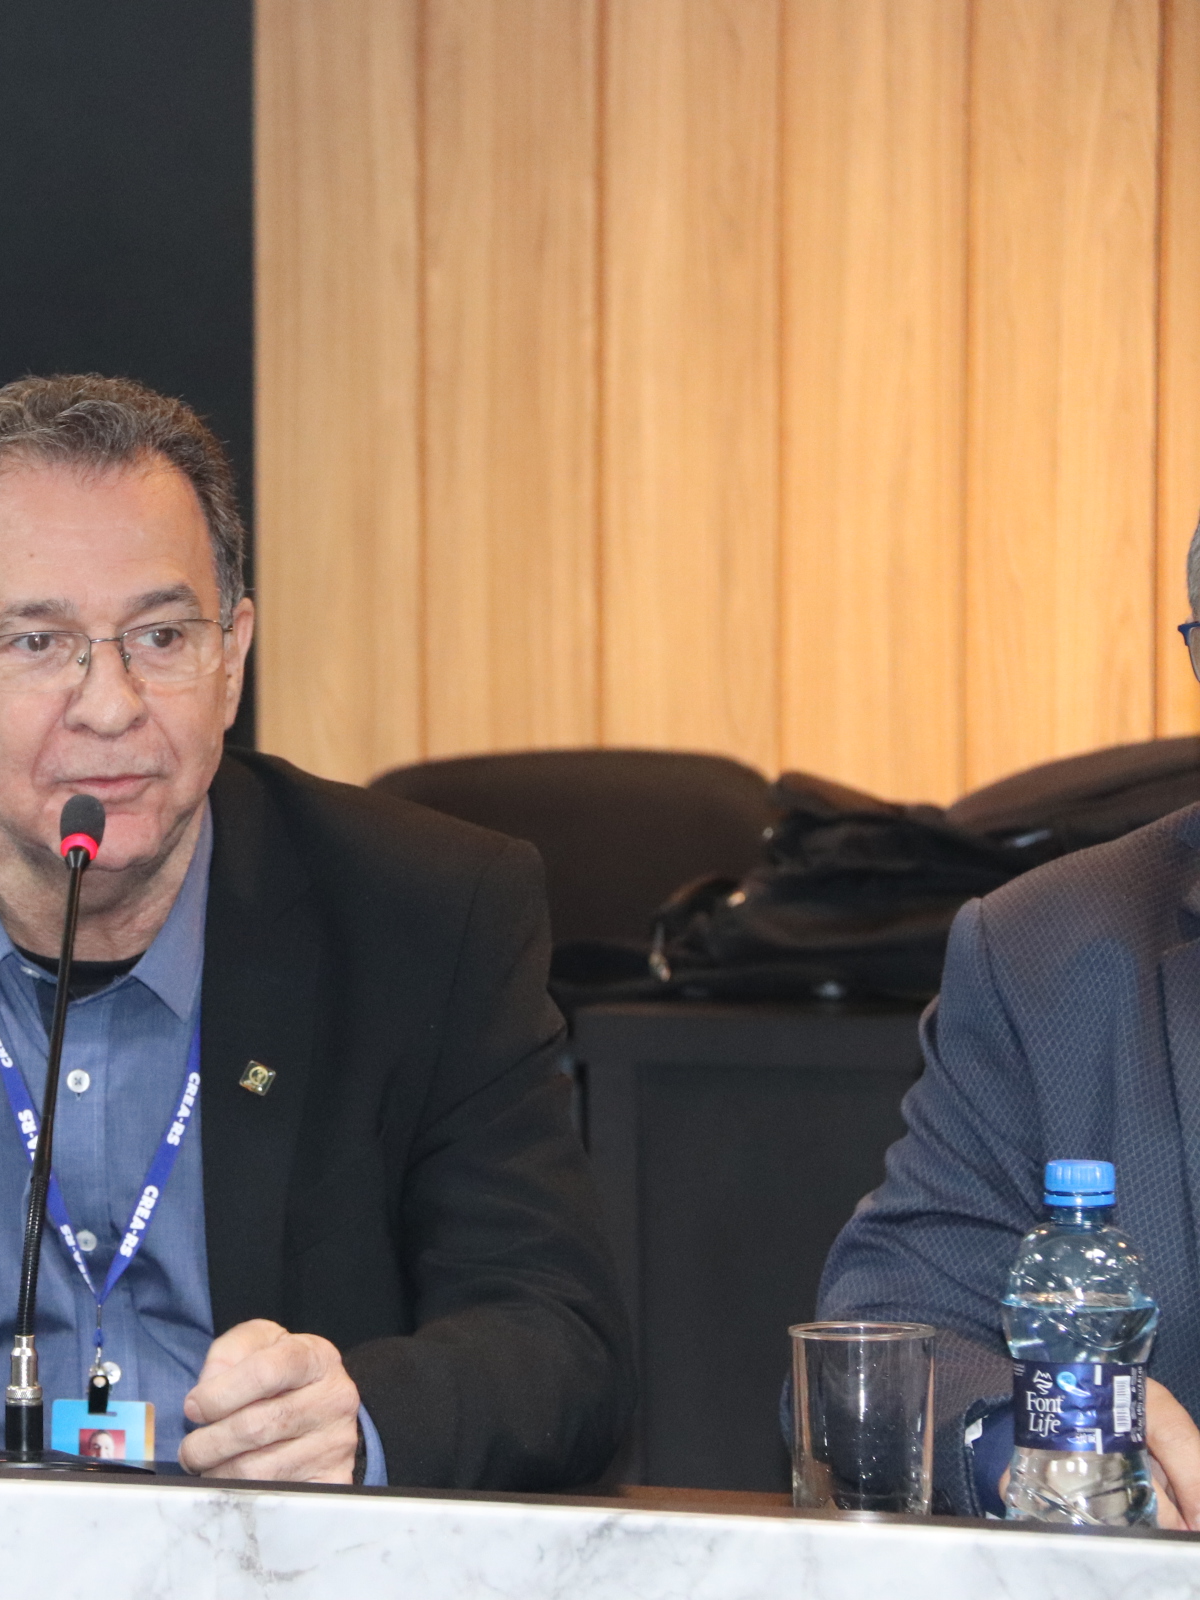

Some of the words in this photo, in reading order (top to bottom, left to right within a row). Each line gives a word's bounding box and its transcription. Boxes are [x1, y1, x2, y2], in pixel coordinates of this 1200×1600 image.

[17, 1109, 39, 1161] A-RS
[166, 1071, 200, 1147] CREA-RS
[120, 1184, 159, 1258] CREA-RS
[1026, 1391, 1064, 1413] Font
[1029, 1413, 1061, 1438] Life
